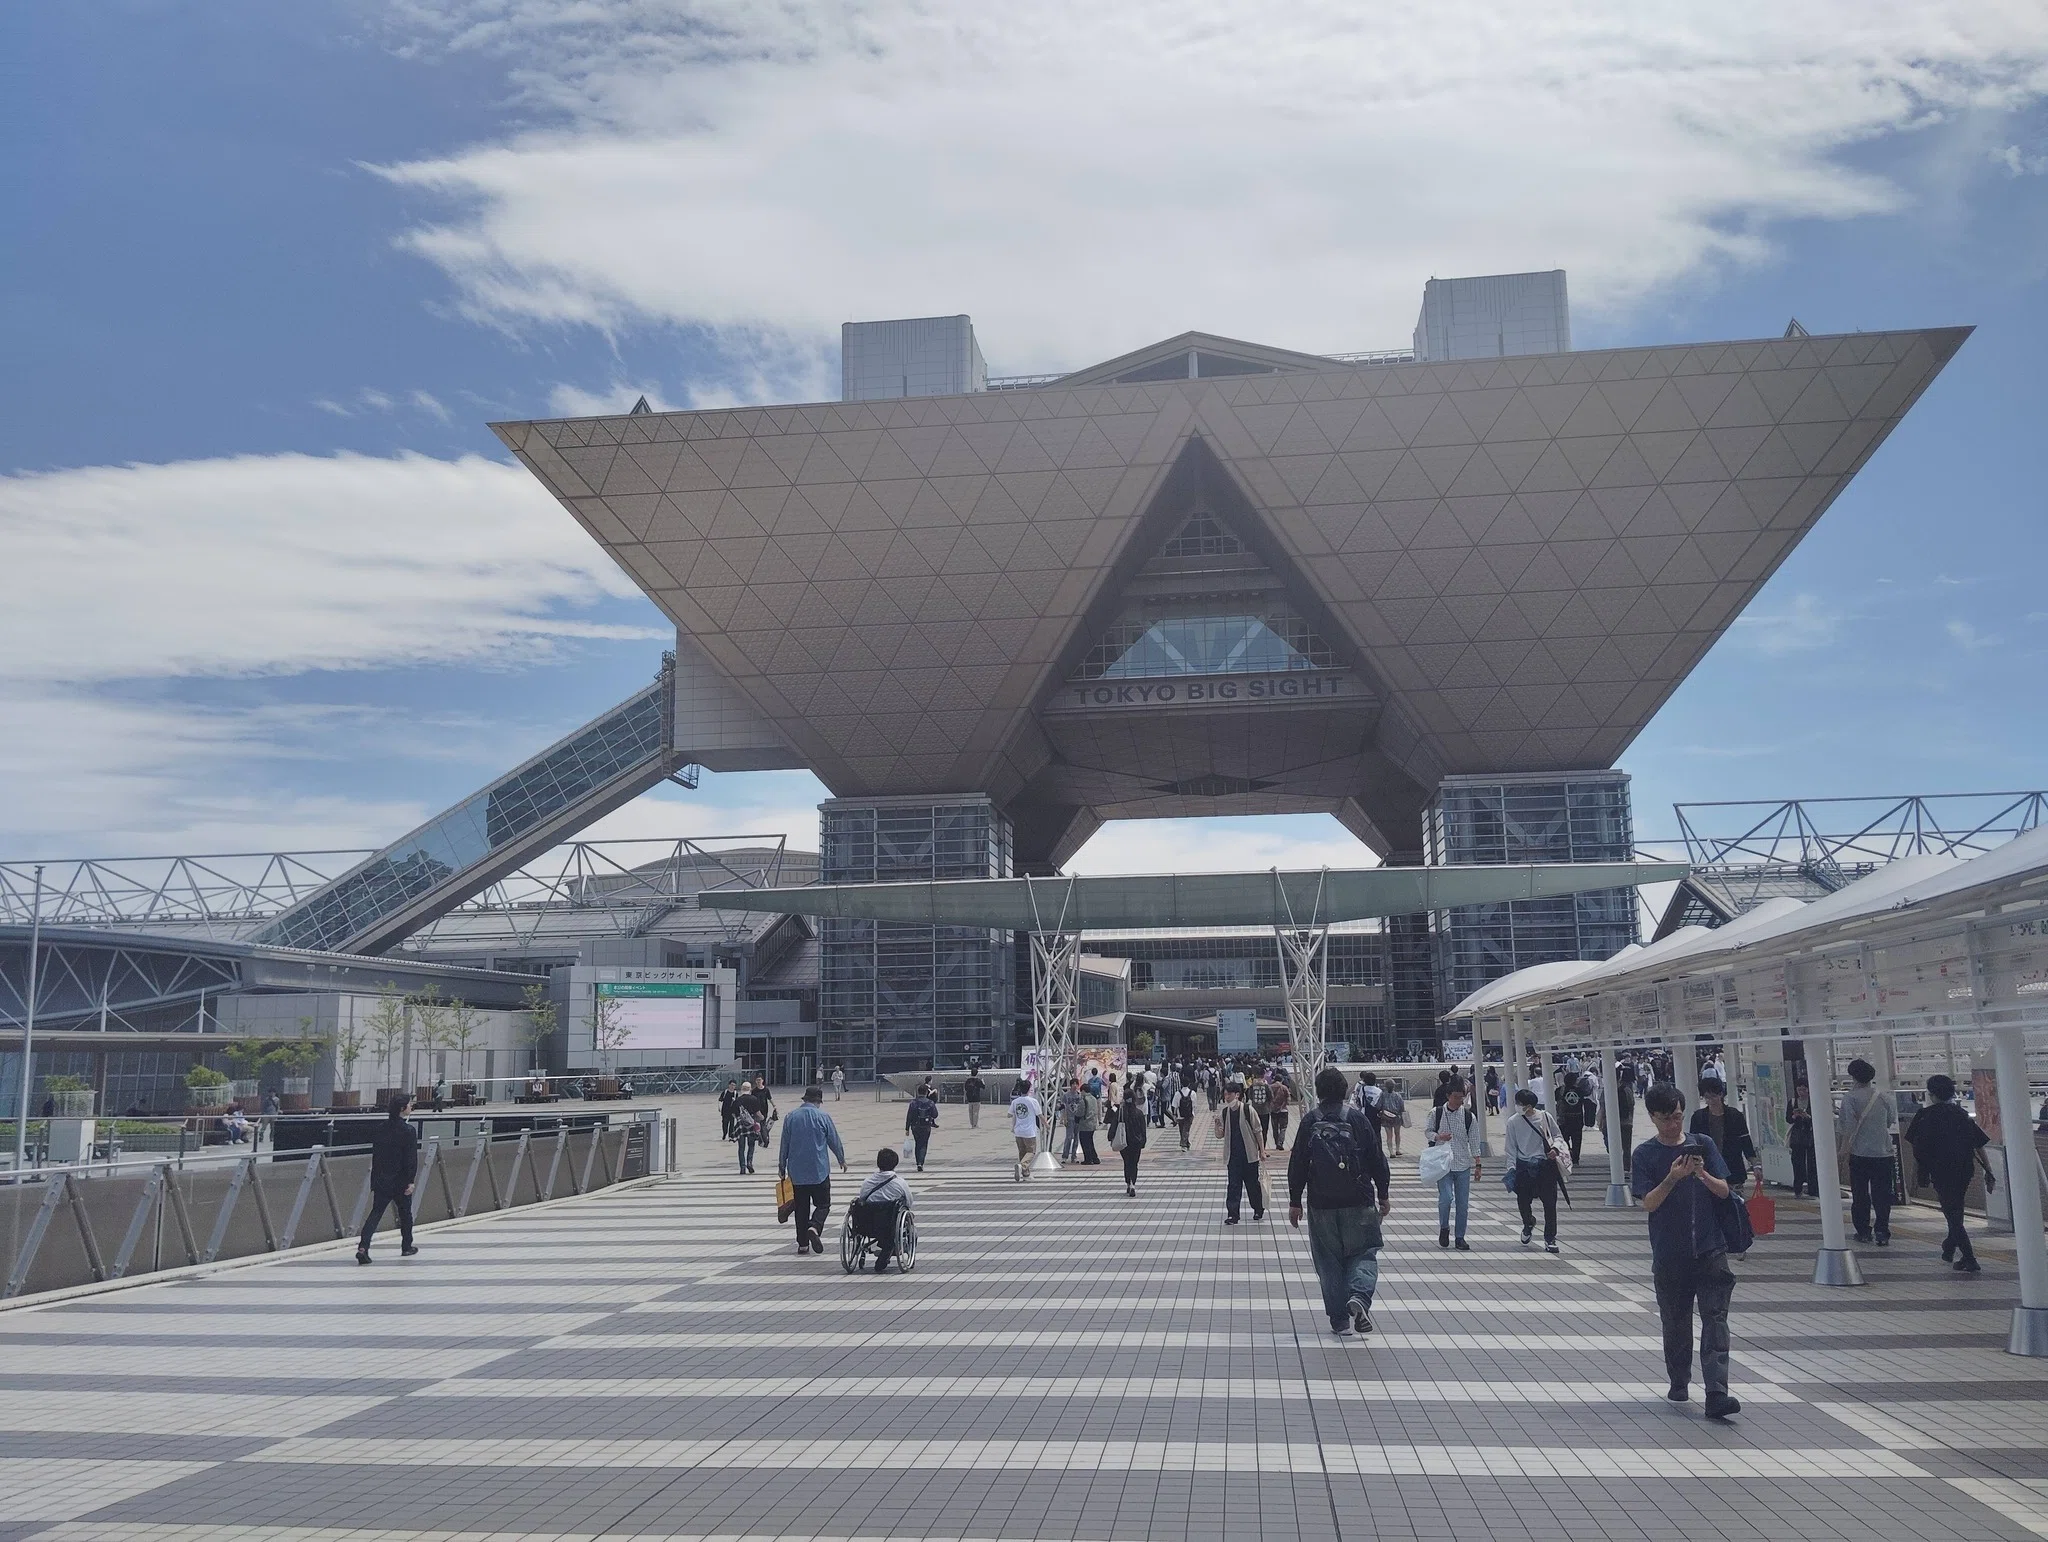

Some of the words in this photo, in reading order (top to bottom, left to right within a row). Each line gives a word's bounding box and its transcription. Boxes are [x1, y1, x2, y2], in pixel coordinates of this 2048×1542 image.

[1073, 684, 1176, 704] TOKYO
[1187, 681, 1238, 700] BIG
[1249, 676, 1344, 698] SIGHT
